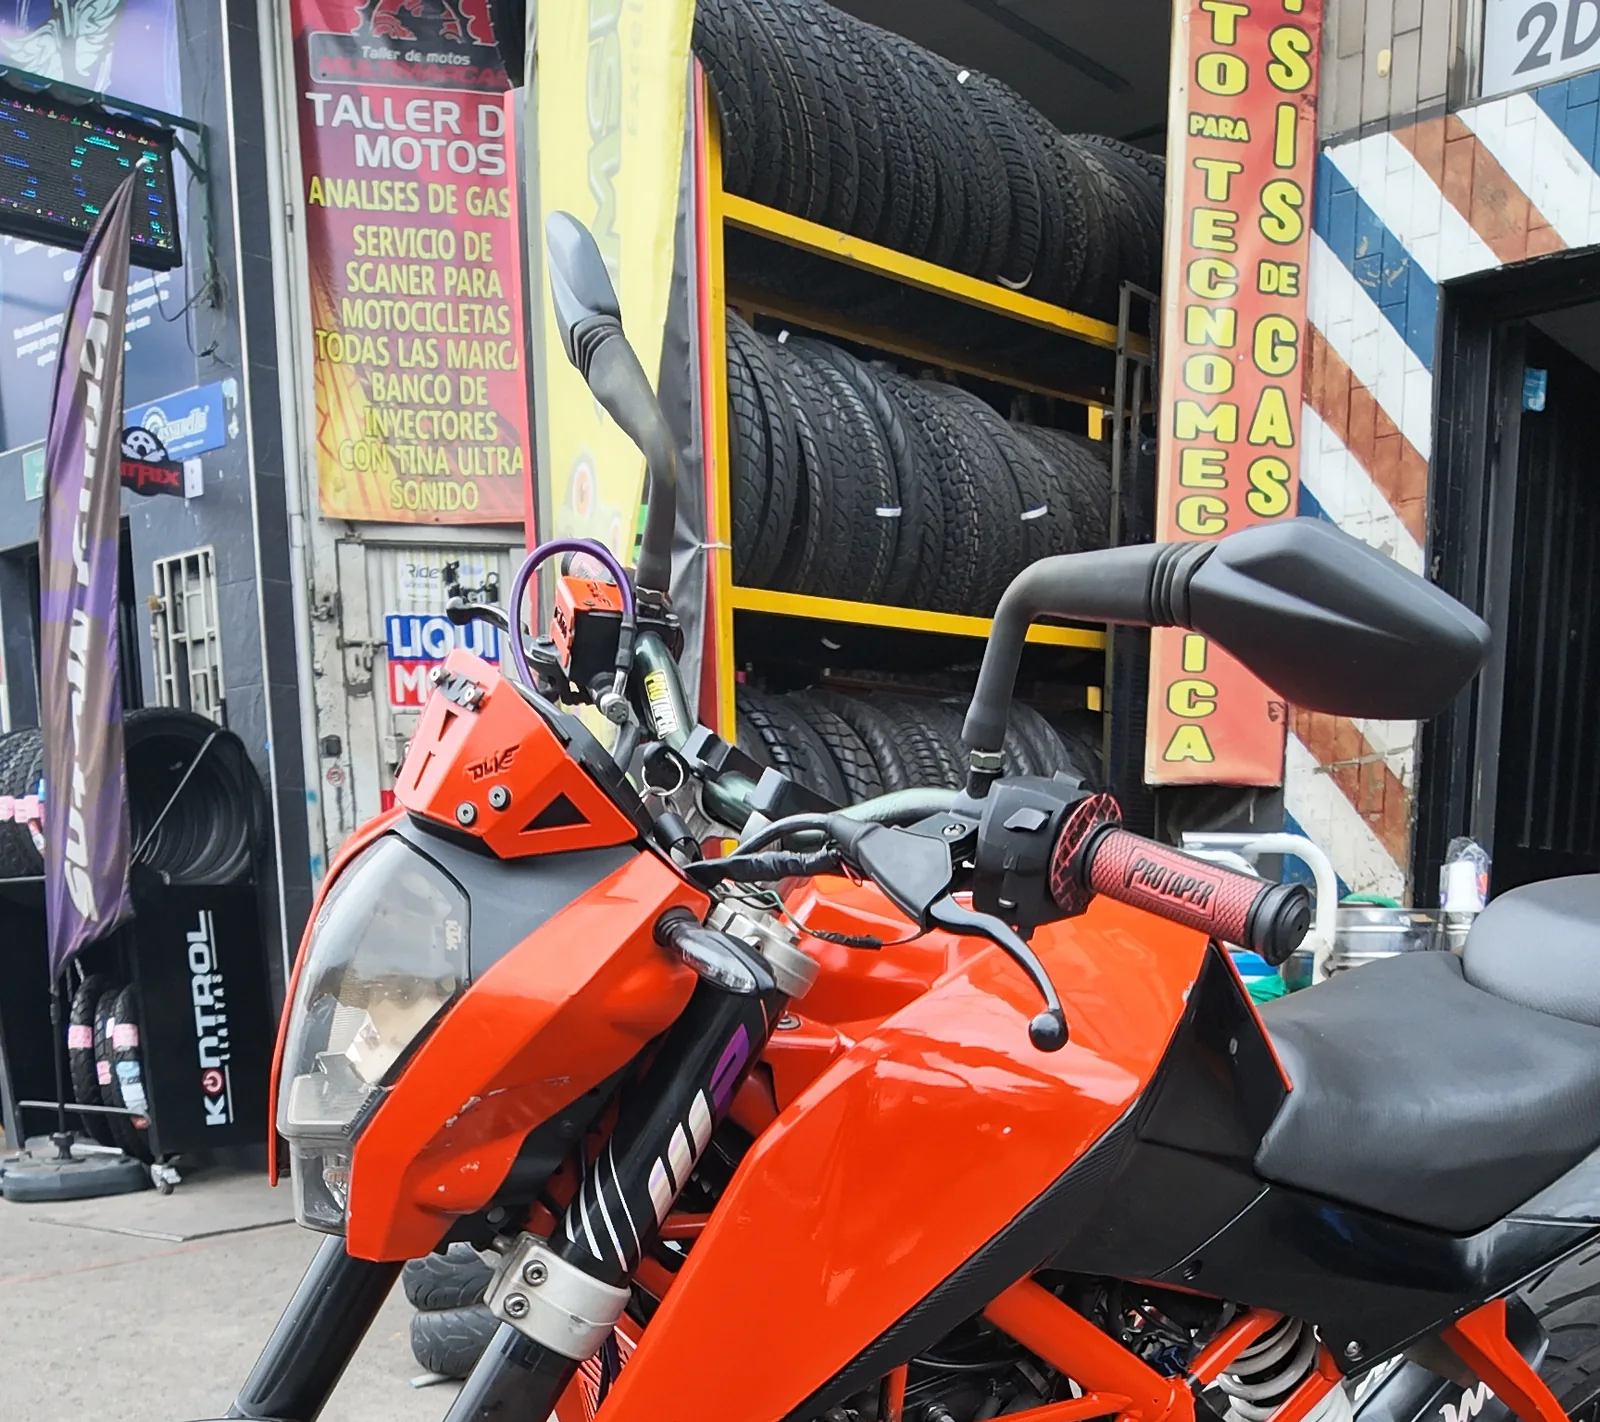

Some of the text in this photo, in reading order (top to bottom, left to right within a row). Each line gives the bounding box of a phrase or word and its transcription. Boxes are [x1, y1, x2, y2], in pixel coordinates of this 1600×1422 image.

[361, 46, 471, 66] Taller de motos
[305, 92, 461, 135] TALLER
[1188, 113, 1250, 143] PARA
[1258, 0, 1313, 245] SIS
[354, 133, 506, 176] MOTOS
[308, 176, 421, 213] ANALISES
[428, 182, 459, 215] DE
[352, 224, 494, 263] SERVICIO DE
[346, 261, 504, 299] SCANER PARA
[1257, 259, 1300, 296] DE
[341, 297, 511, 336] MOTOCICLETAS
[315, 329, 390, 367] TODAS
[397, 337, 440, 369] LAS
[371, 371, 490, 407] BANCO DE
[363, 405, 499, 441] INYECTORES
[338, 439, 524, 476] CON TINA ULTRA
[1162, 157, 1244, 763] TECNOMECICA
[390, 478, 480, 511] SONIDO
[390, 617, 495, 659] LIQUI
[467, 745, 521, 781] DUKE
[1124, 857, 1215, 909] PROTAPER
